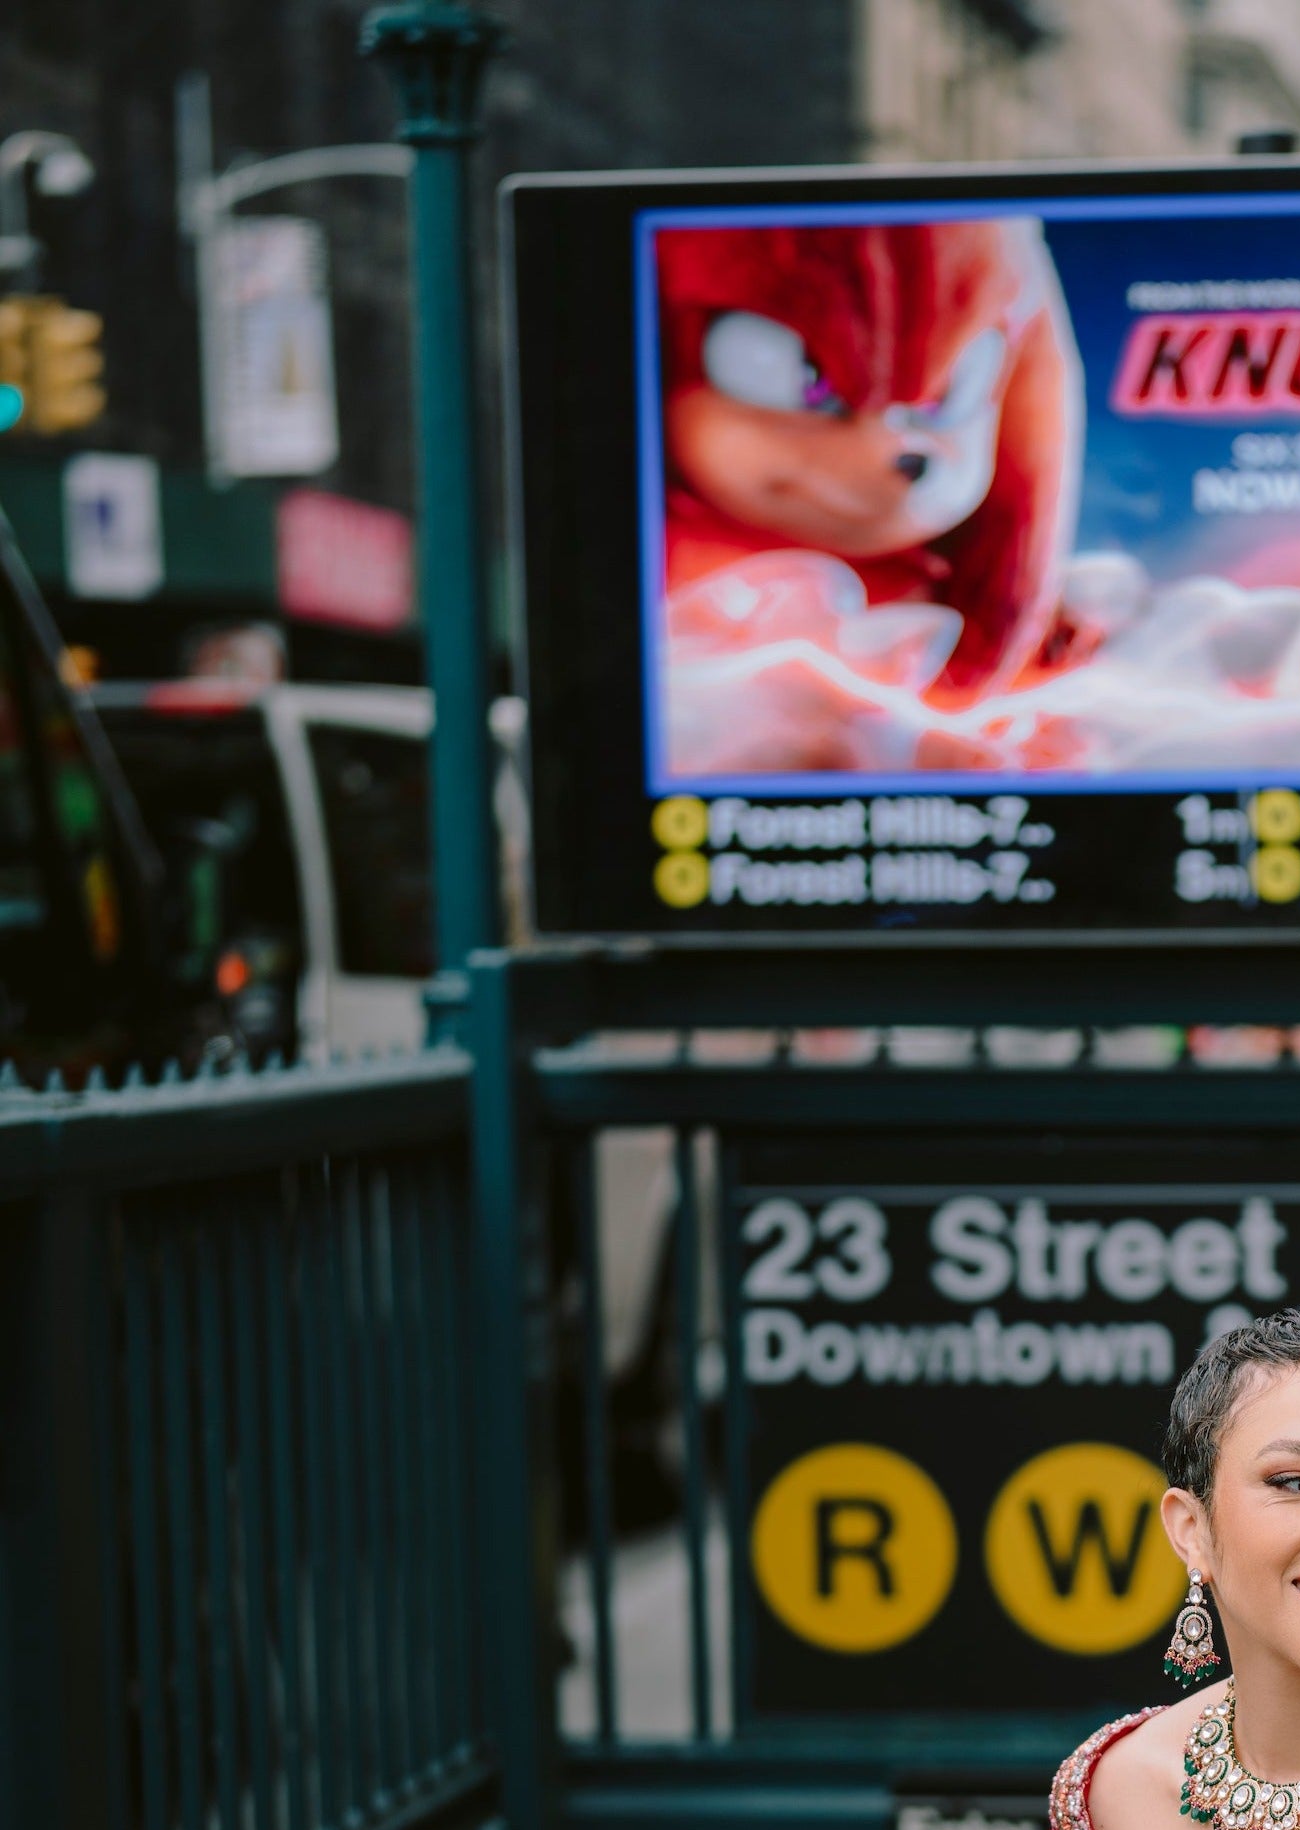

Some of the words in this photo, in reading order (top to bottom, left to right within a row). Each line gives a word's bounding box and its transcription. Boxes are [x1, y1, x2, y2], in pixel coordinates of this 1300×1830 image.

[742, 1198, 892, 1302] 23
[929, 1198, 1288, 1302] Street
[742, 1308, 1176, 1386] Downtown
[813, 1496, 896, 1601] R
[1024, 1496, 1154, 1601] W
